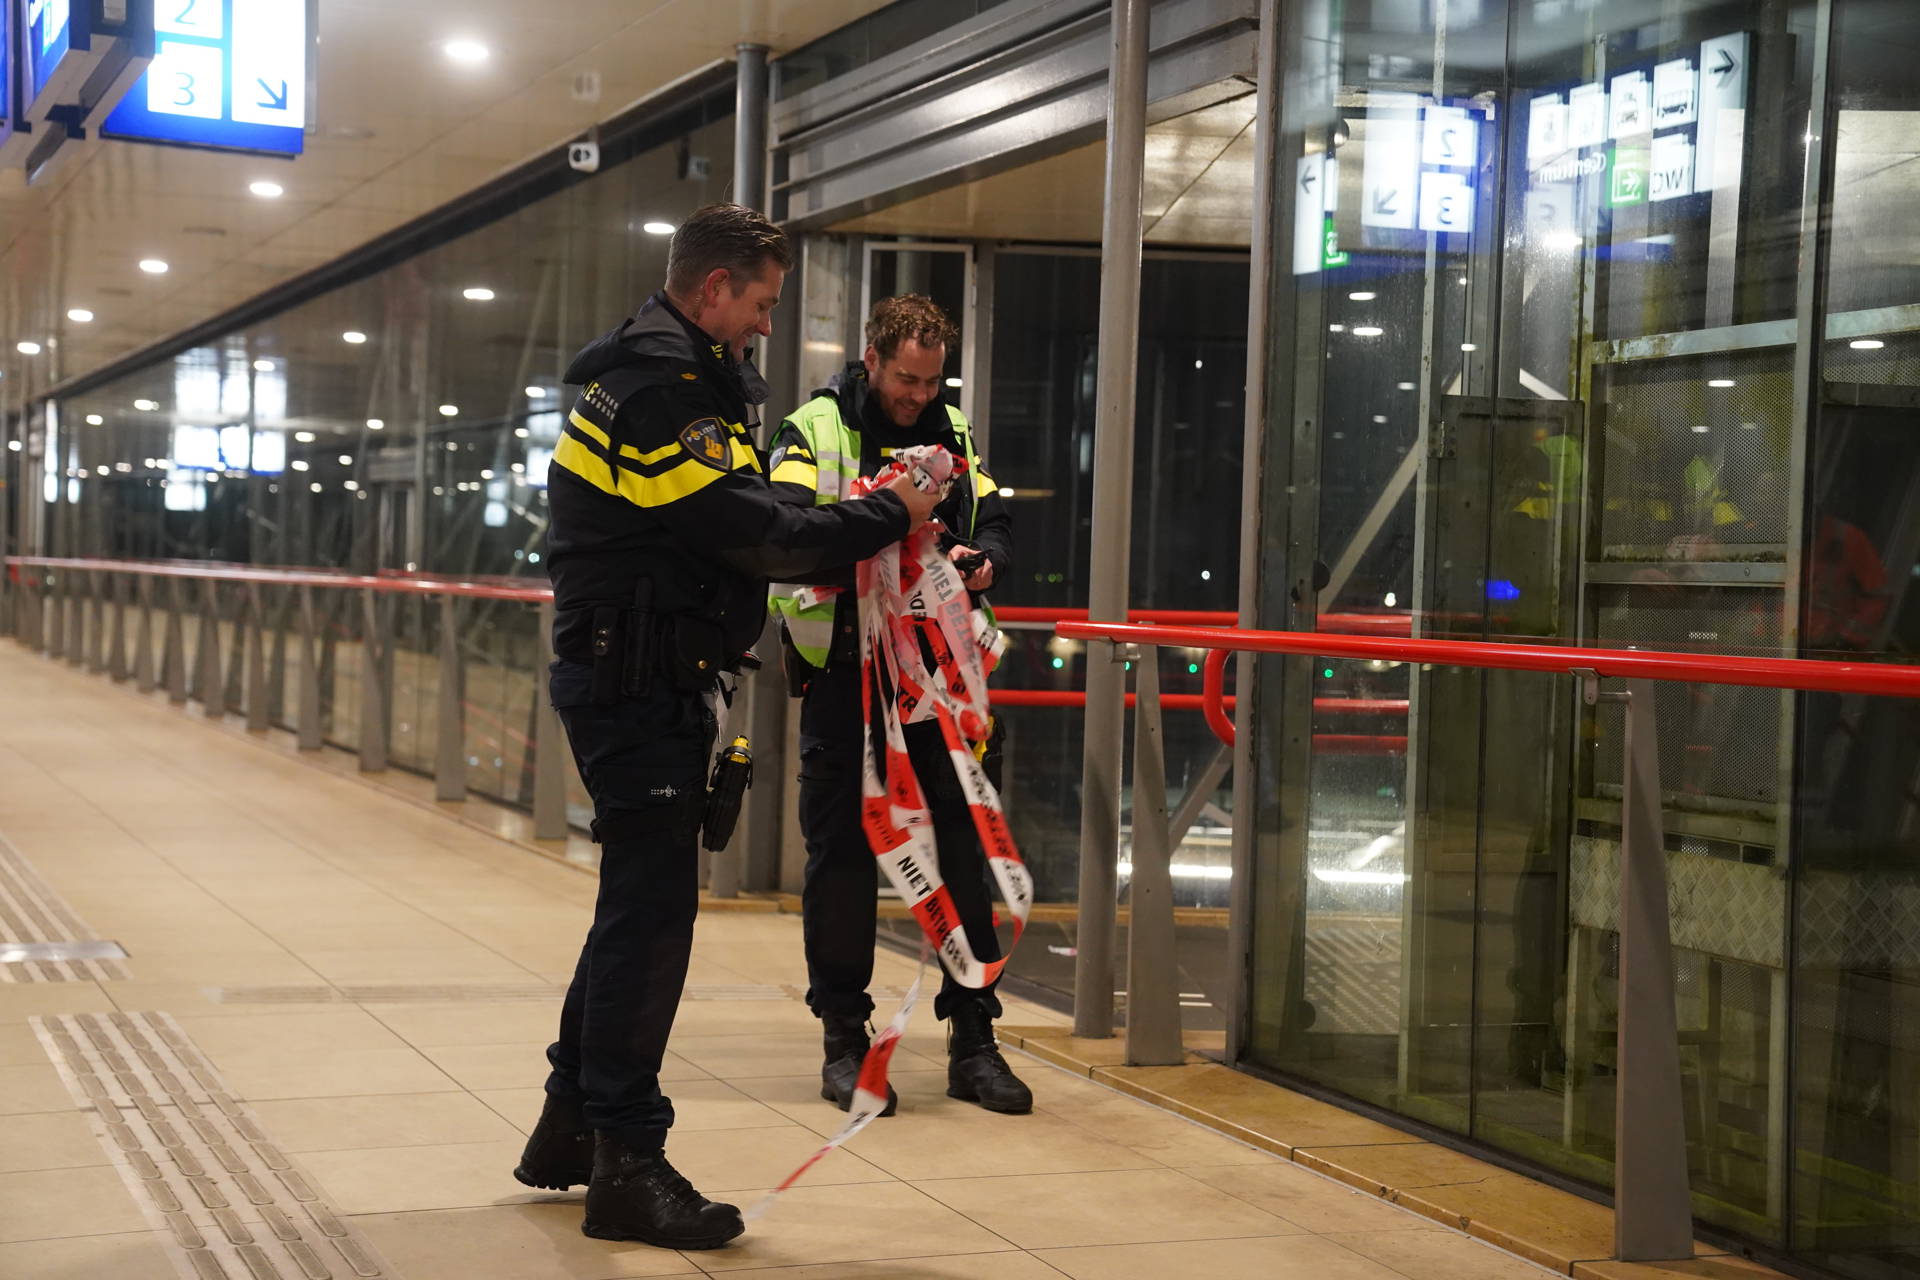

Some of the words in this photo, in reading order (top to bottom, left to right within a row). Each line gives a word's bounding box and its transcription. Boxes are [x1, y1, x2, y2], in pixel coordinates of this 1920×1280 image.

[174, 0, 198, 25] 2
[173, 72, 196, 106] 3
[896, 855, 933, 897] NIET
